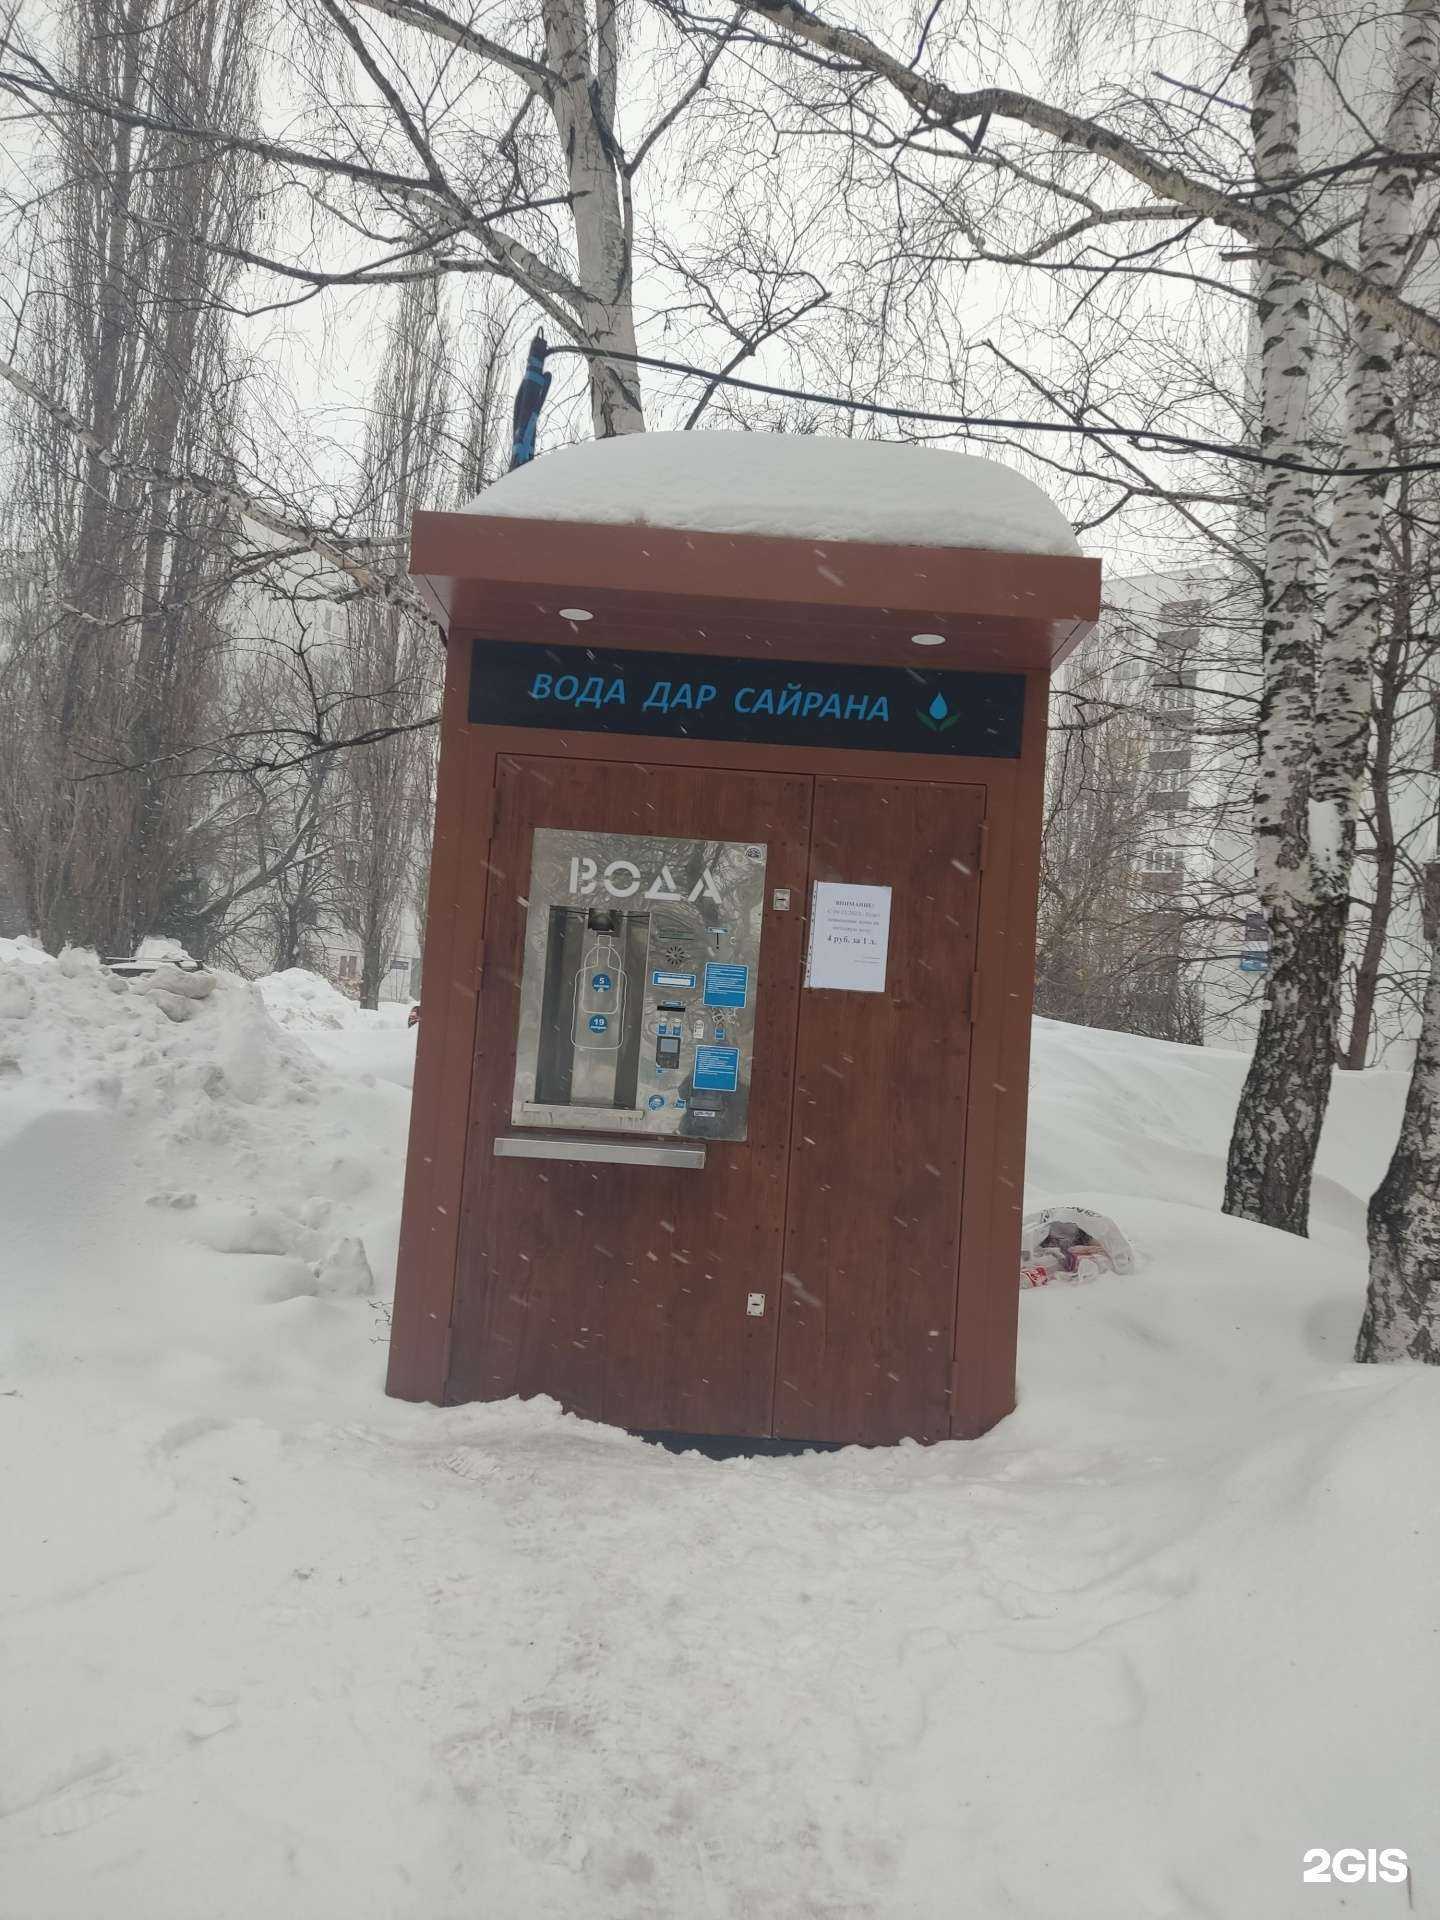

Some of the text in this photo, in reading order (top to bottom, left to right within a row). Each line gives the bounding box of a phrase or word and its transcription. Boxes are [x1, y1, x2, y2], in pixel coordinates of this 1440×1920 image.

[531, 673, 890, 721] ВОДА ДАР САЙРАНА
[569, 857, 722, 904] ВОДА
[593, 1018, 605, 1026] 19
